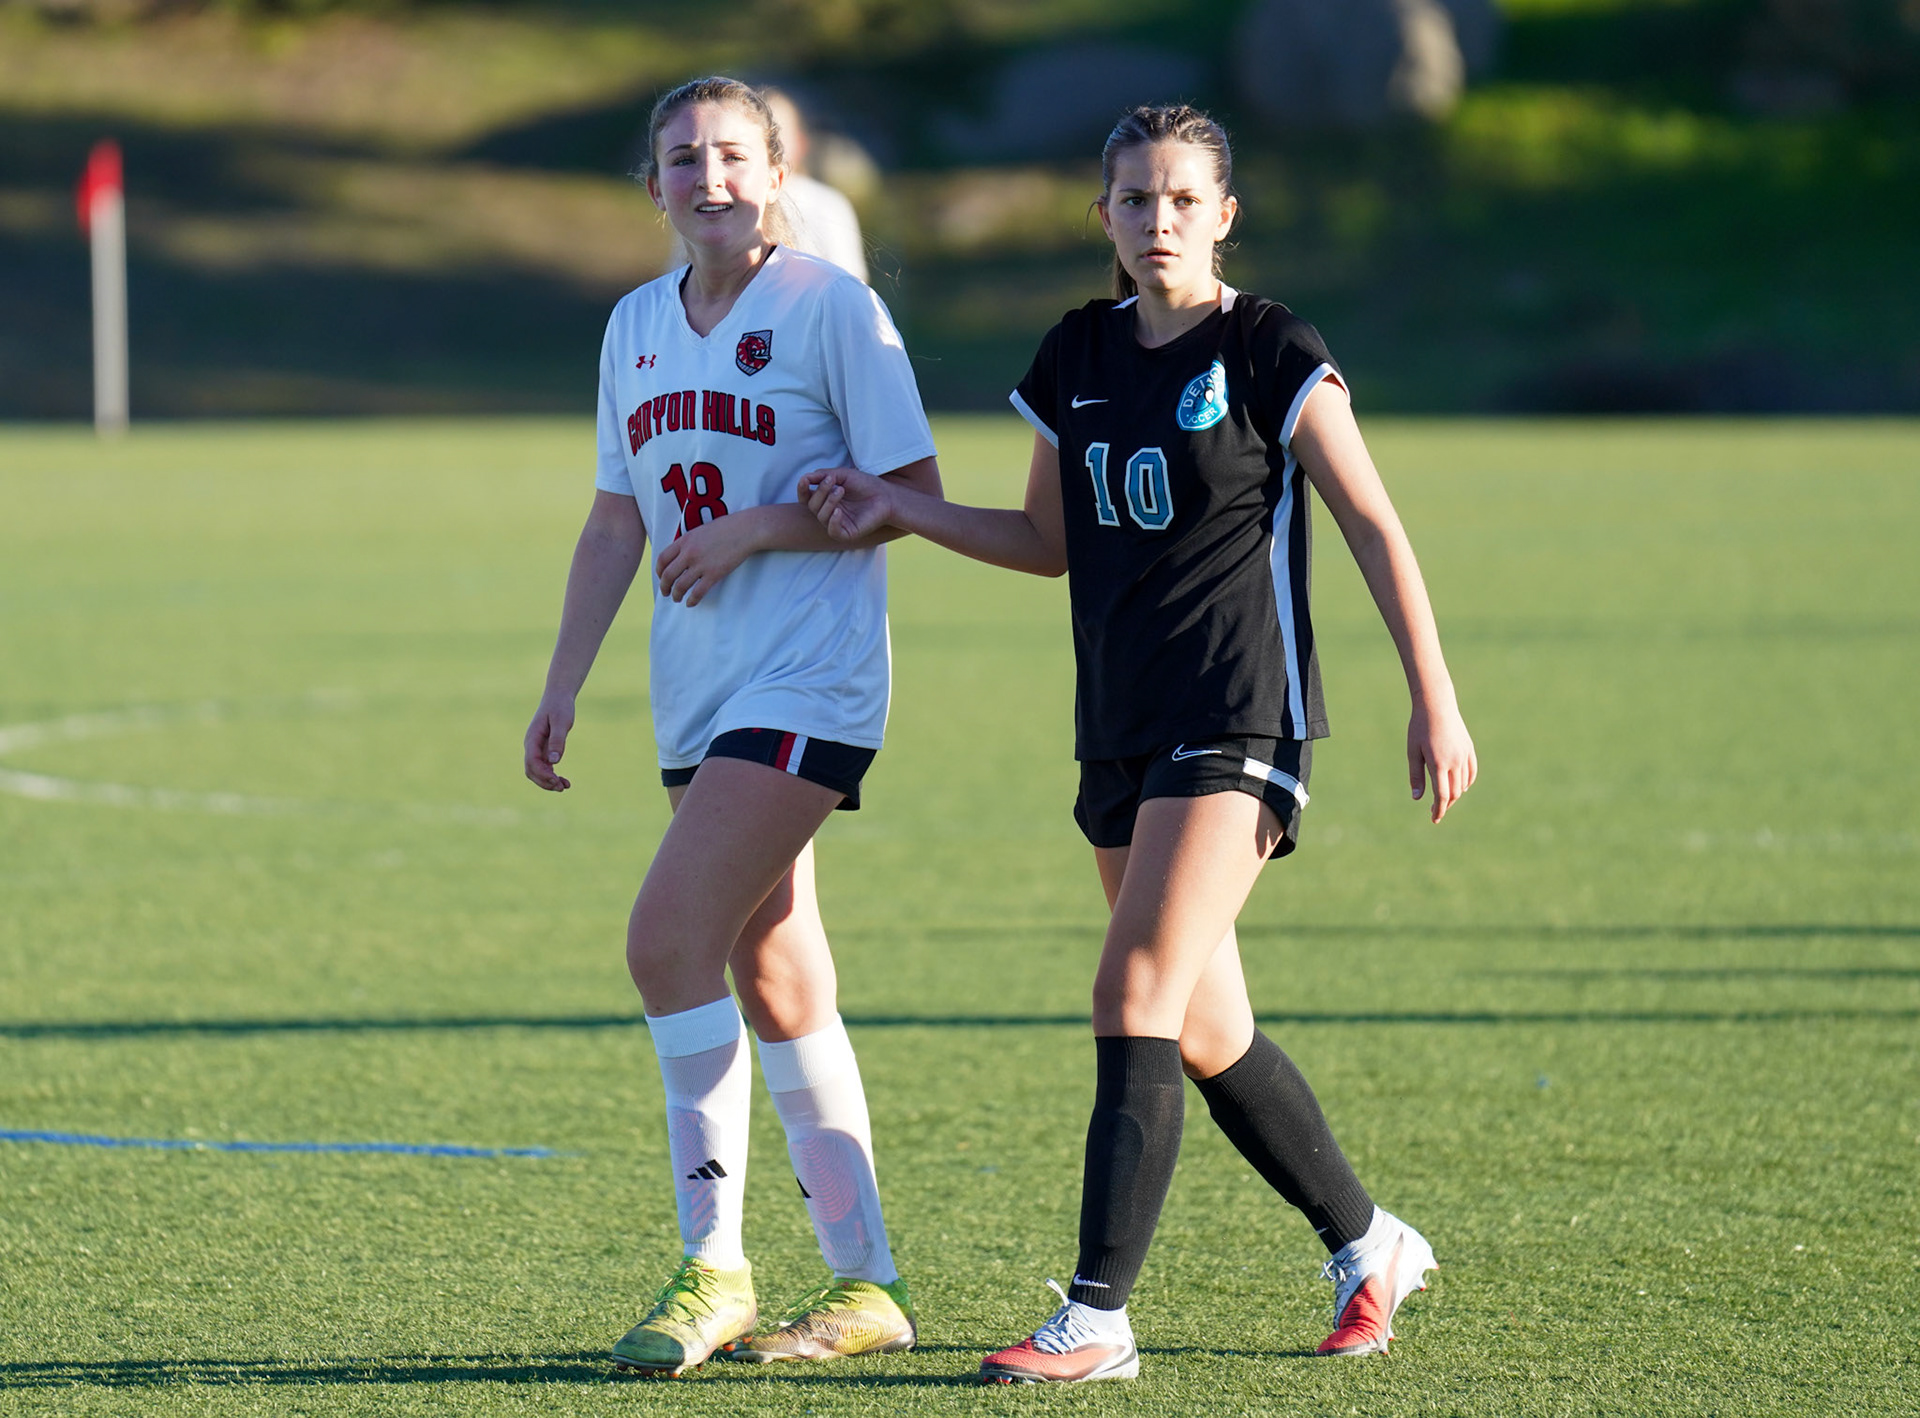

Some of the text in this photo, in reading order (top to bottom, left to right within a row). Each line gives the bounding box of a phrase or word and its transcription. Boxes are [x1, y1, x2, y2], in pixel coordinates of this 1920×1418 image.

[627, 389, 776, 457] CANYON HILLS
[660, 461, 729, 542] 18
[1085, 441, 1175, 530] 10
